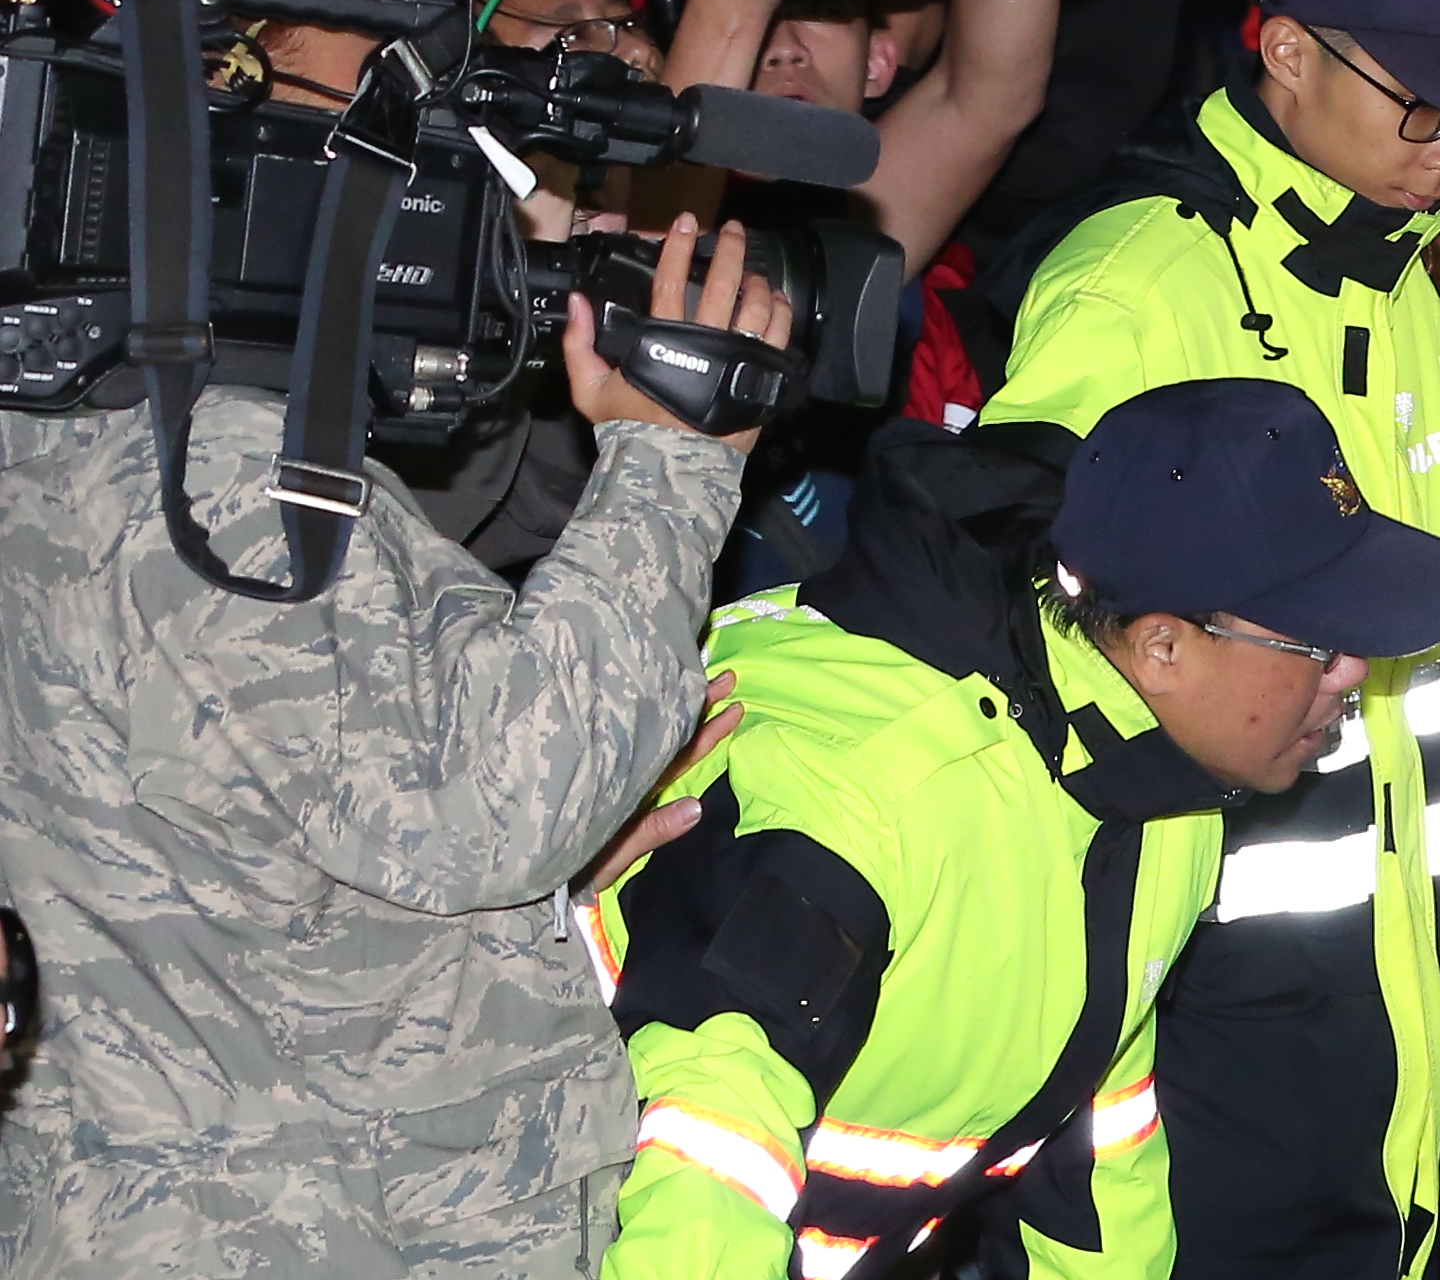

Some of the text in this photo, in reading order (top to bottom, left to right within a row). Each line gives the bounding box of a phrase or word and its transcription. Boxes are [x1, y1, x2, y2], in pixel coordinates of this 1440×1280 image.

[400, 194, 445, 214] onic
[376, 263, 434, 286] 2HD
[647, 342, 711, 375] Canon
